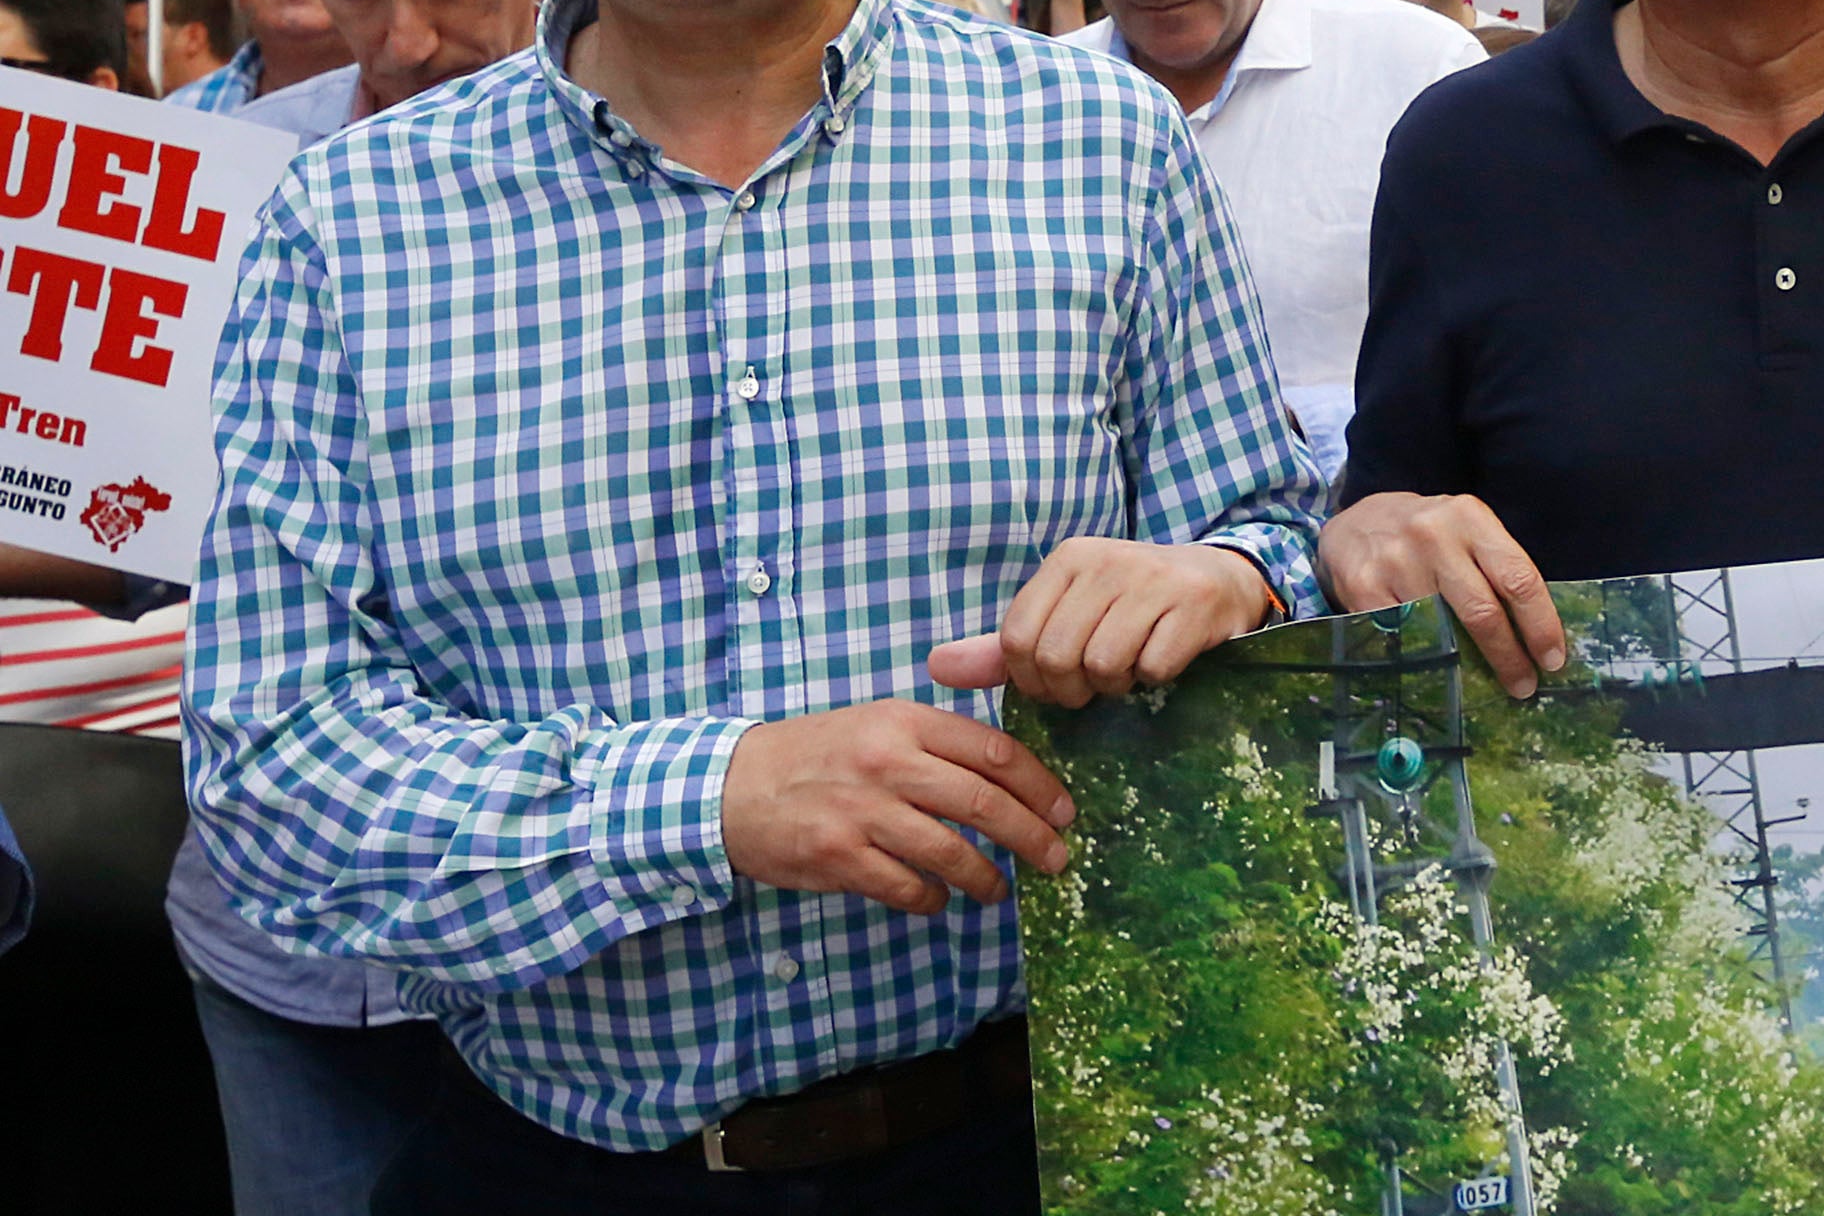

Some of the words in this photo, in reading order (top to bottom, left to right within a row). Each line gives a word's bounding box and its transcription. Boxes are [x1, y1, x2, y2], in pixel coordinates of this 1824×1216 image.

[0, 106, 226, 263] UEL
[0, 245, 189, 388] TE
[0, 465, 72, 498] RÁNEO
